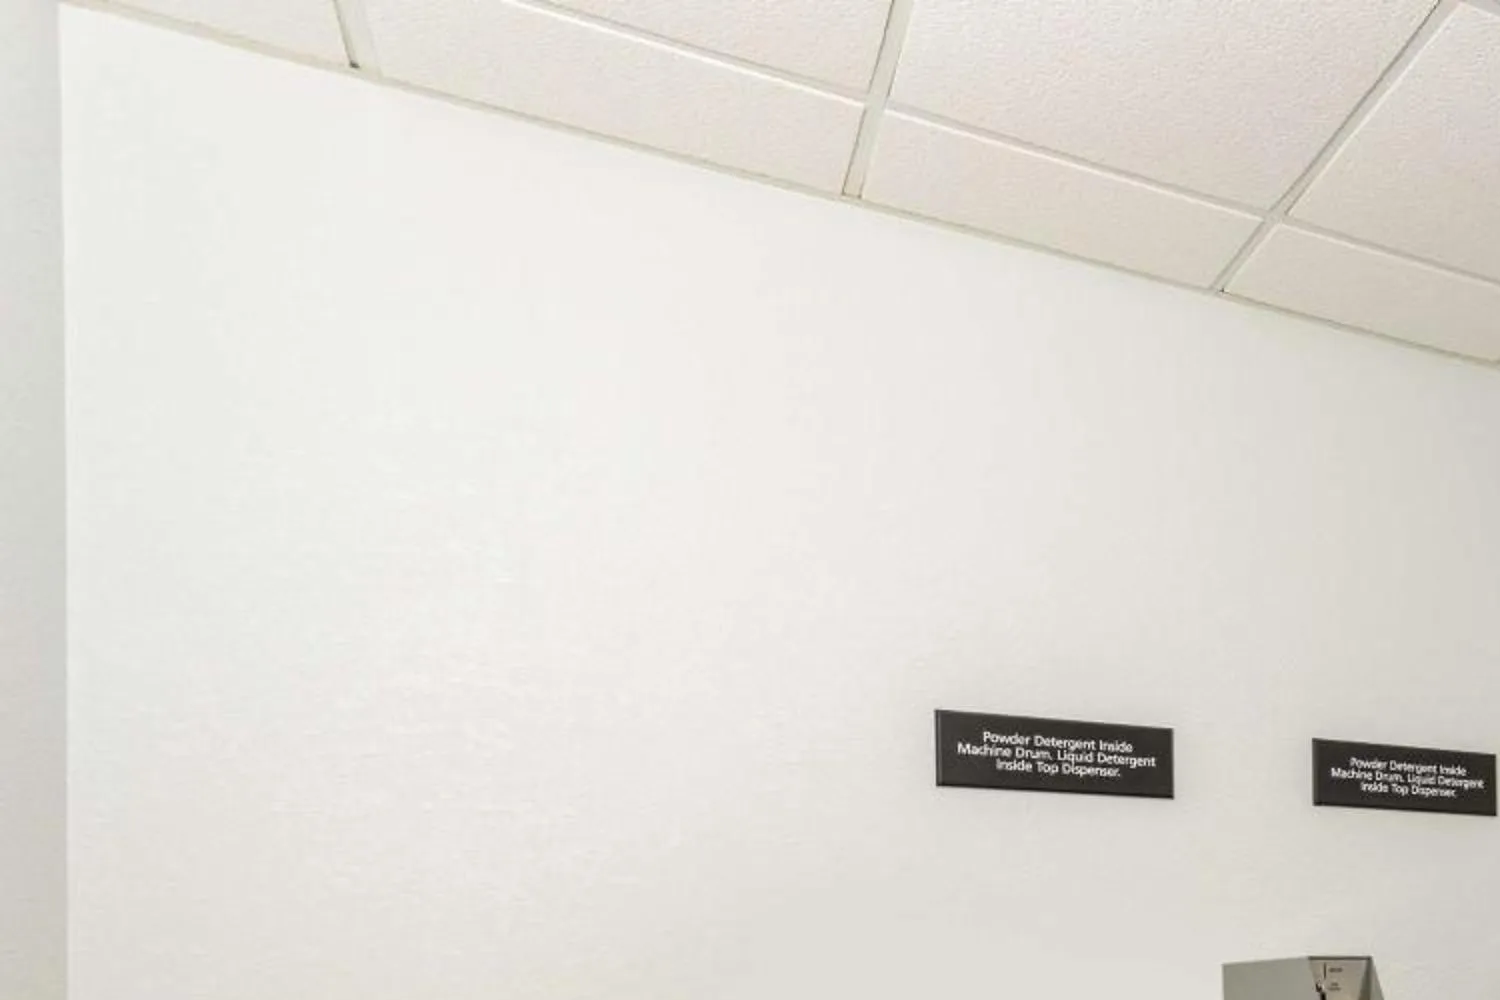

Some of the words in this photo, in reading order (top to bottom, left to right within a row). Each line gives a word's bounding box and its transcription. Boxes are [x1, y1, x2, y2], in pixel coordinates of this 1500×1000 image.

[983, 731, 1030, 746] Powder
[1034, 735, 1096, 751] Detergent
[1099, 740, 1133, 753] Inside
[957, 742, 1012, 757] Machine
[1057, 750, 1094, 765] Liquid
[1097, 752, 1156, 769] Detergent
[996, 758, 1033, 772] Inside
[1036, 761, 1059, 776] Top
[1062, 763, 1121, 777] Dispenser.
[1350, 757, 1387, 770] Powder
[1389, 760, 1437, 774] Detergent
[1439, 764, 1467, 776] Inside
[1331, 767, 1373, 780] Machine
[1407, 773, 1436, 786] Liquid
[1438, 776, 1484, 790] Detergent
[1361, 781, 1389, 793] Inside
[1391, 783, 1409, 796] Top
